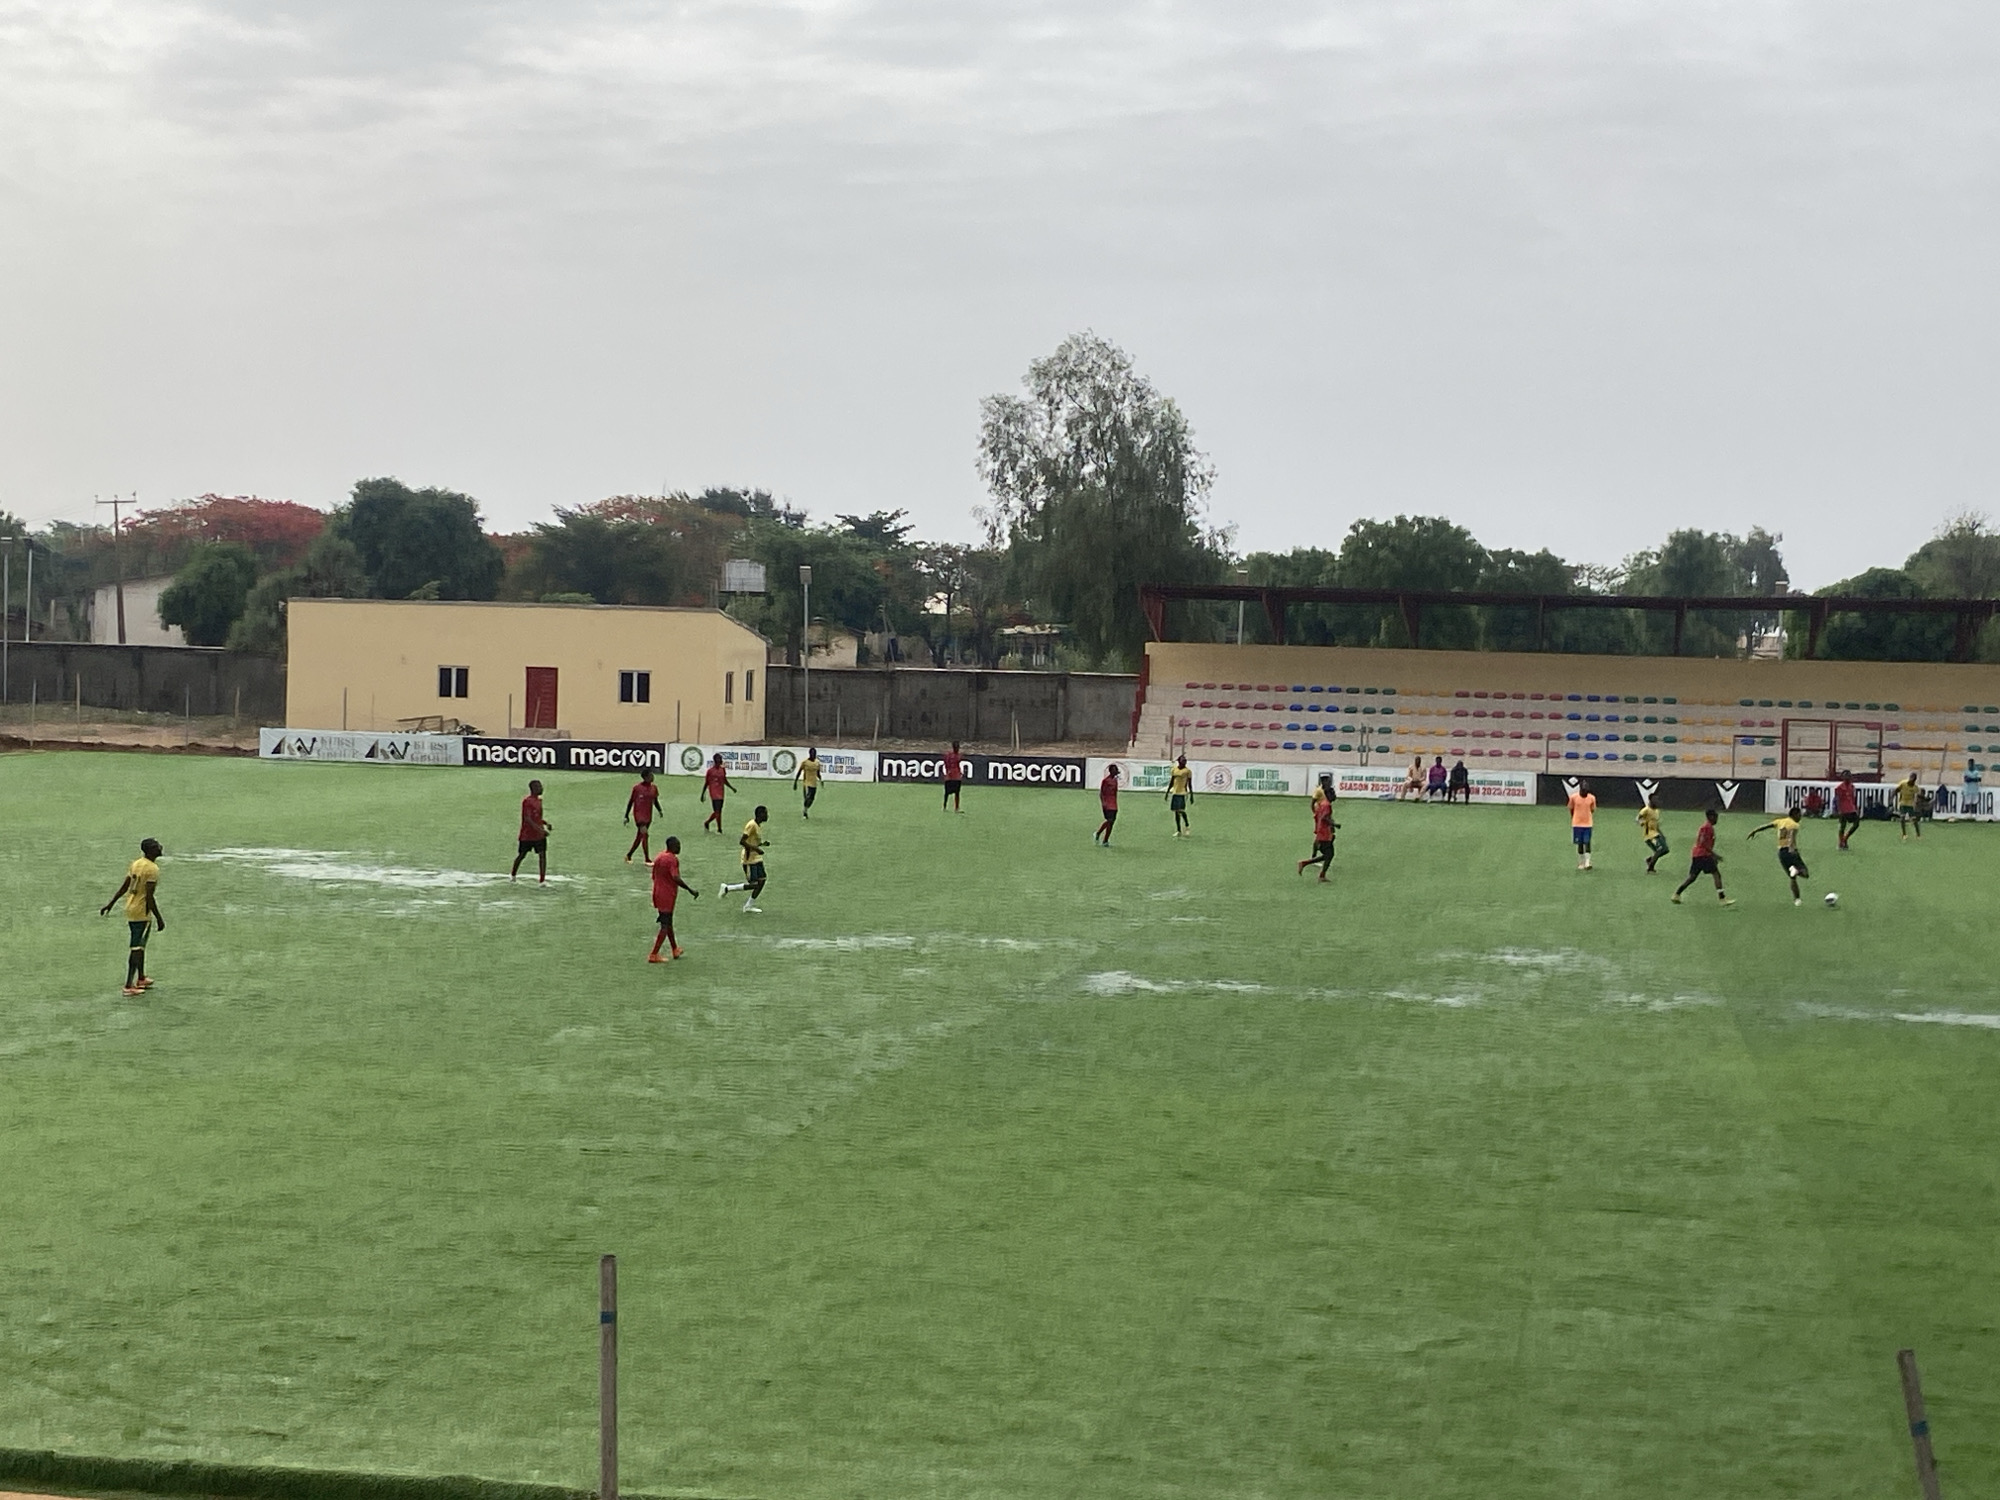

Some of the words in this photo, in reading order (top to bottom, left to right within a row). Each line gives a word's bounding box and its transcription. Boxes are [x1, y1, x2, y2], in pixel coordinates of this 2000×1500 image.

[467, 744, 556, 764] macron
[570, 747, 661, 768] macron
[882, 758, 974, 779] macrn
[988, 761, 1081, 782] macron
[1339, 782, 1369, 791] SEASON
[1482, 787, 1527, 797] 2025/2026
